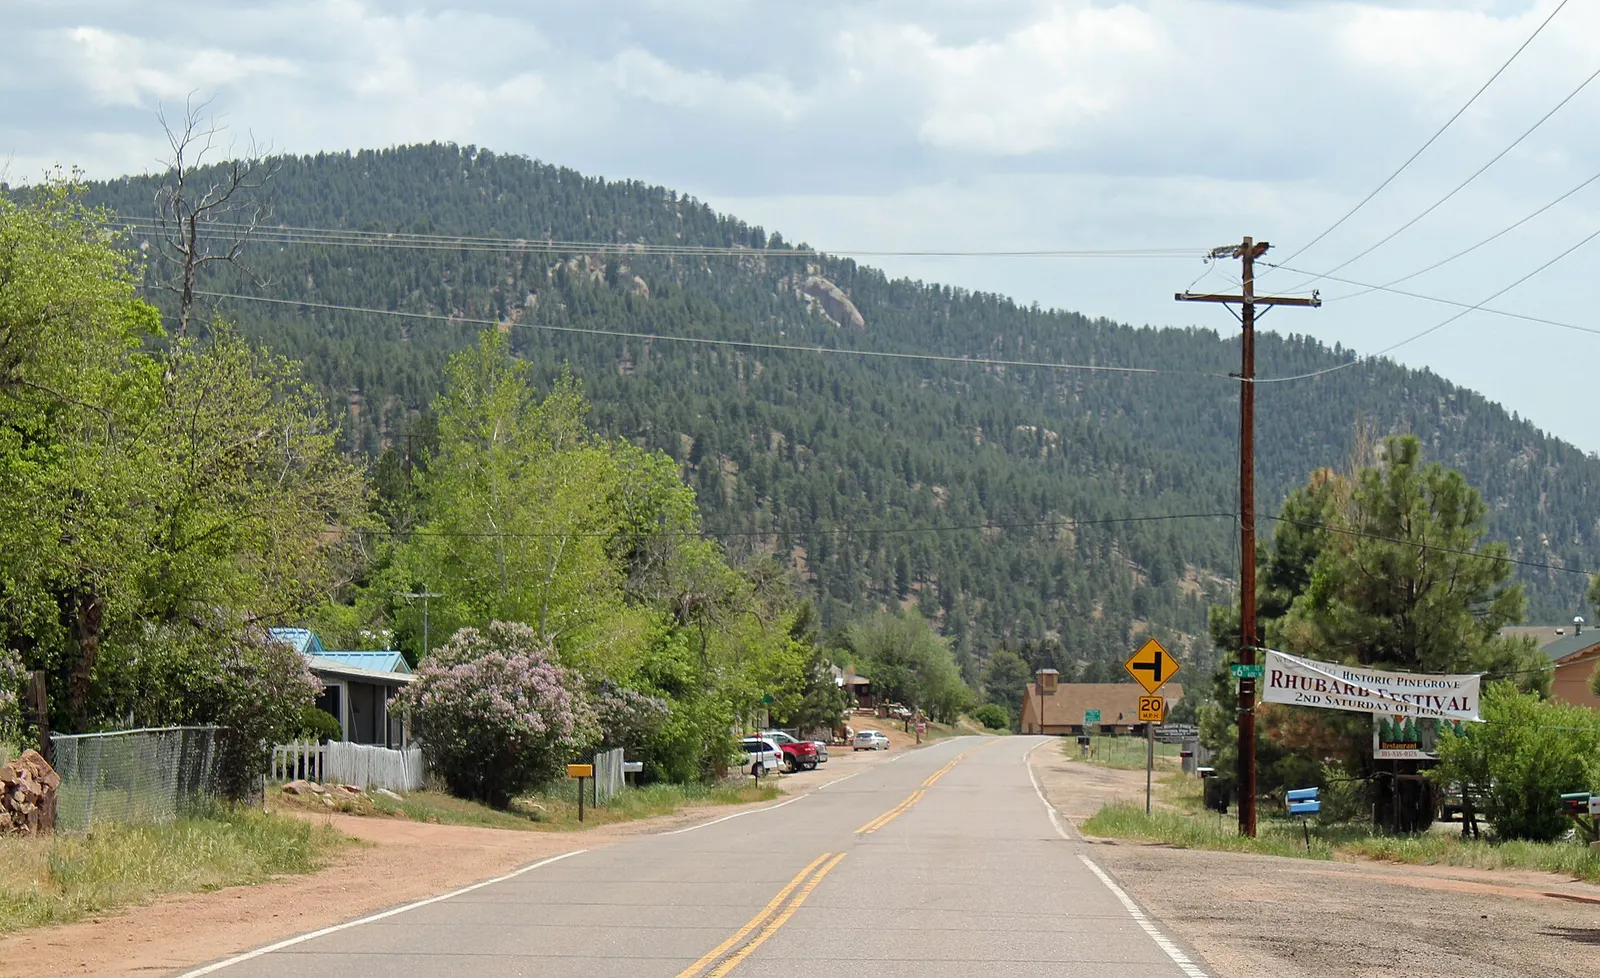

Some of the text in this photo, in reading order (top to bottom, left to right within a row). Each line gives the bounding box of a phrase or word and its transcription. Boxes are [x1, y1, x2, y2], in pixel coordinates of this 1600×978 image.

[1342, 670, 1393, 686] HISTORIC
[1270, 669, 1472, 712] RHUBARB FESTIVAL
[1141, 699, 1160, 711] 20
[1295, 692, 1447, 717] 2ND SATURDAY OF JUNE
